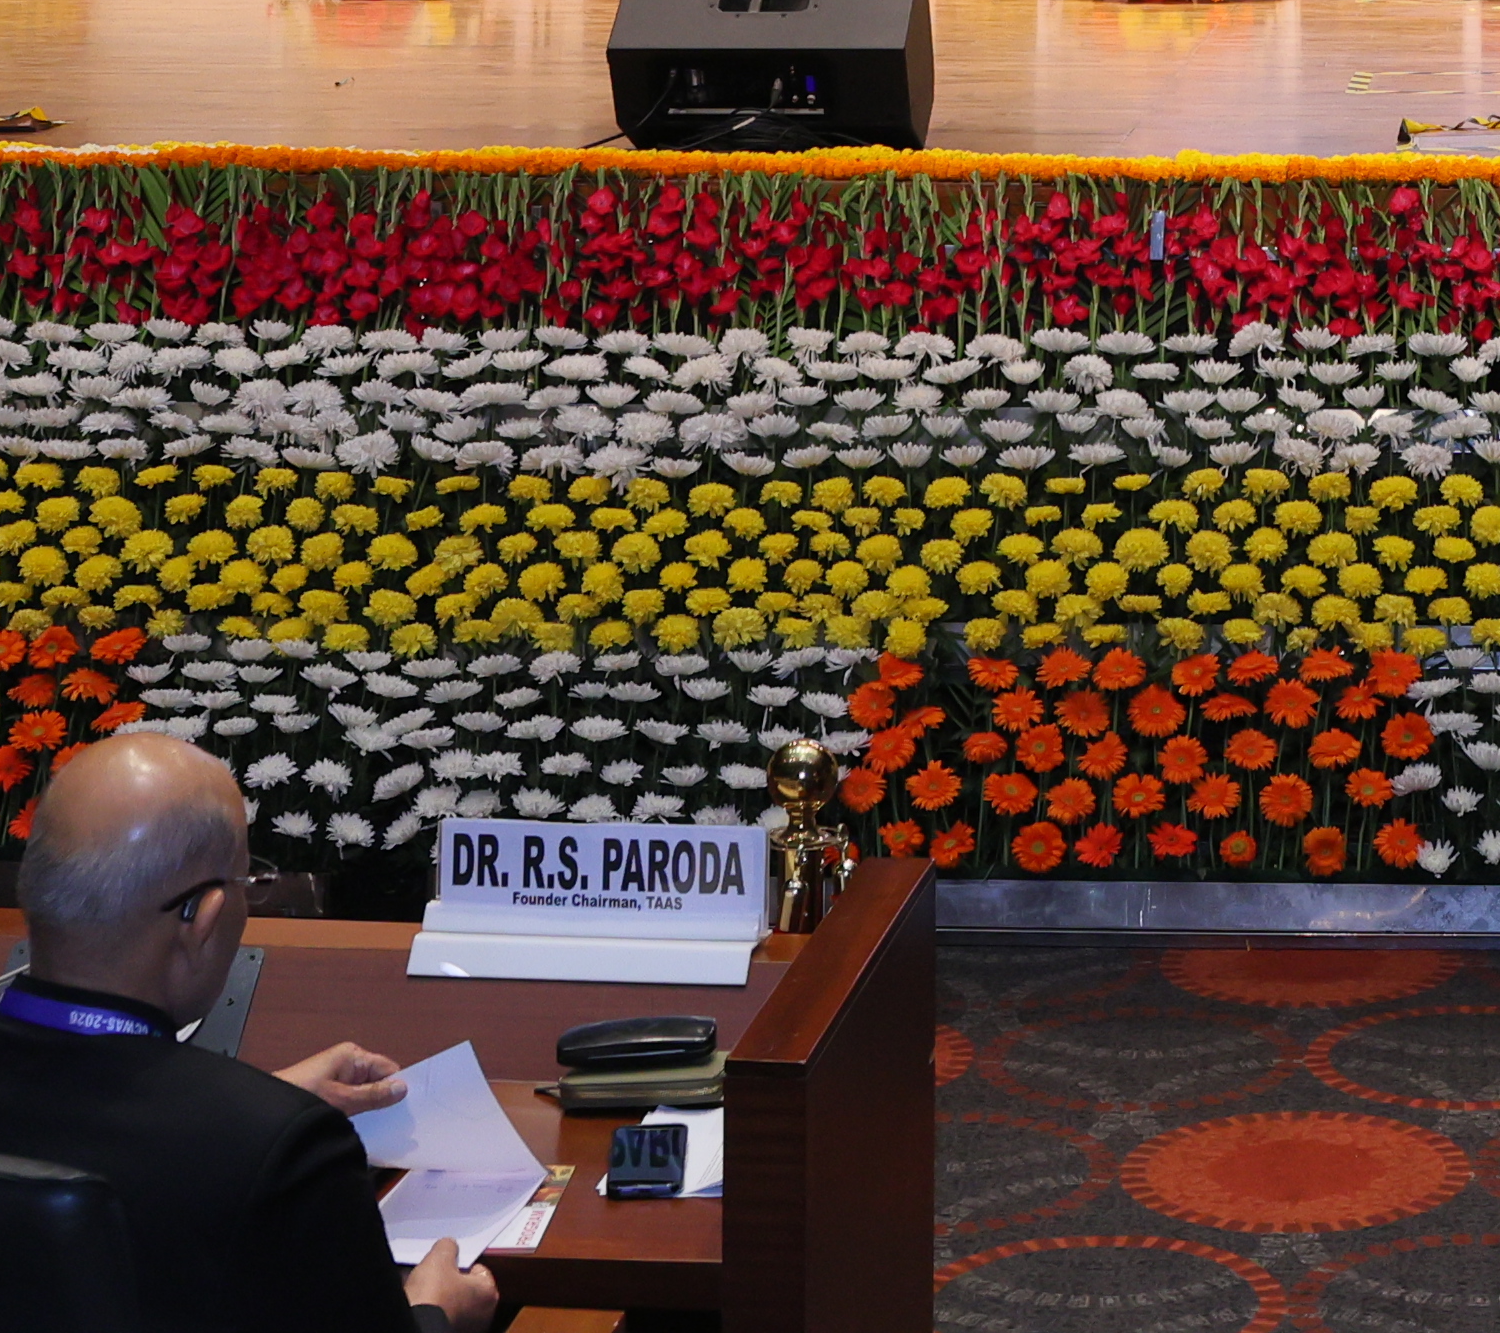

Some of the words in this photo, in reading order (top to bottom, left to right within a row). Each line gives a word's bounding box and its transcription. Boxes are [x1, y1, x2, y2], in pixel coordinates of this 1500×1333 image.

[453, 833, 508, 887] DR.
[523, 836, 588, 890] R.S.
[602, 838, 744, 895] PARODA
[513, 892, 568, 907] Founder
[572, 894, 642, 911] Chairman,
[646, 896, 682, 910] TAAS
